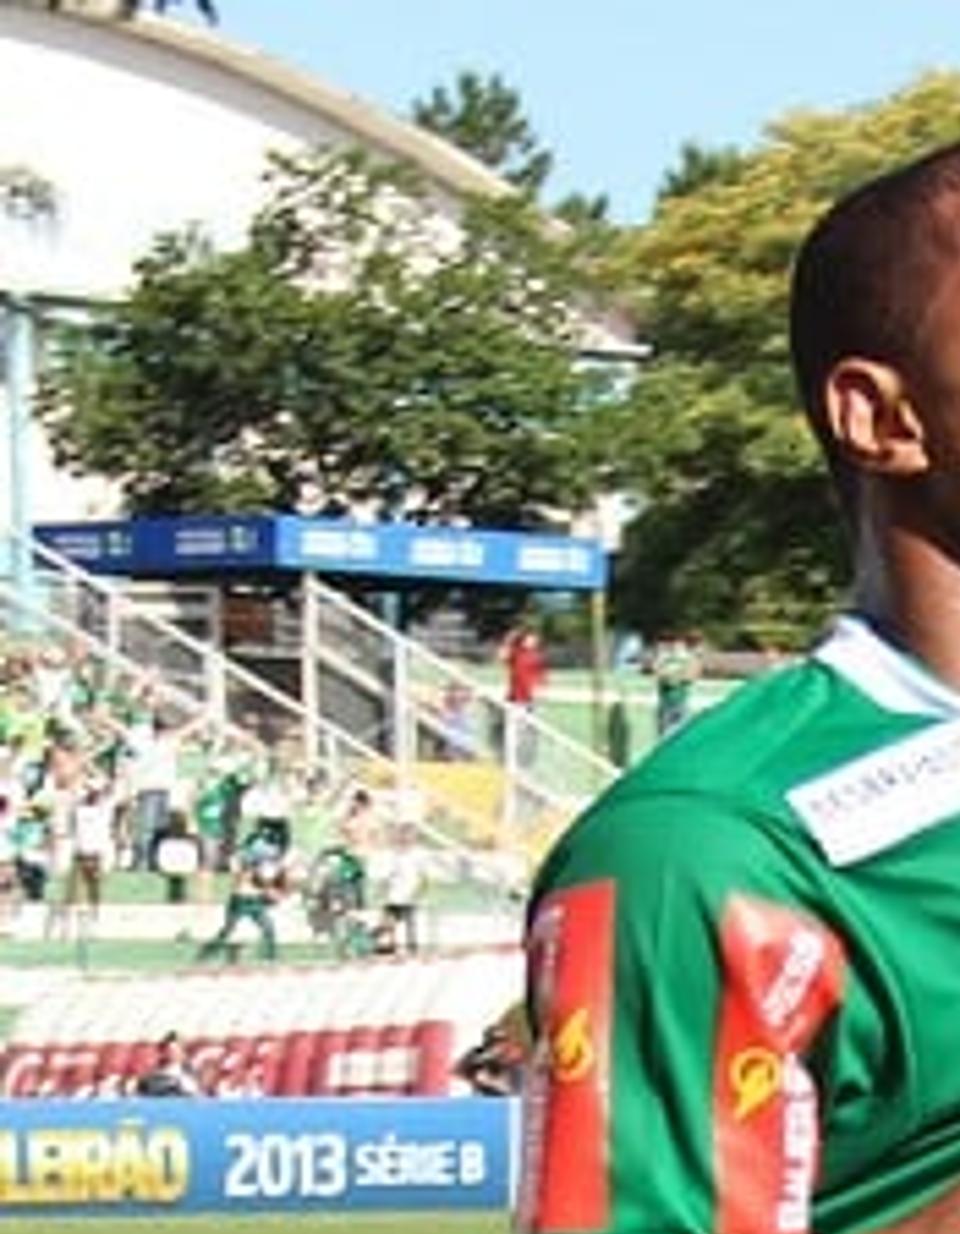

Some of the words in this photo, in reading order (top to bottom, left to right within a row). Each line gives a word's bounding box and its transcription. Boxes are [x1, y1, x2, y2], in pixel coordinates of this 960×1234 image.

[223, 1132, 348, 1198] 2013
[354, 1127, 456, 1187] SÉRIE
[459, 1140, 486, 1187] B
